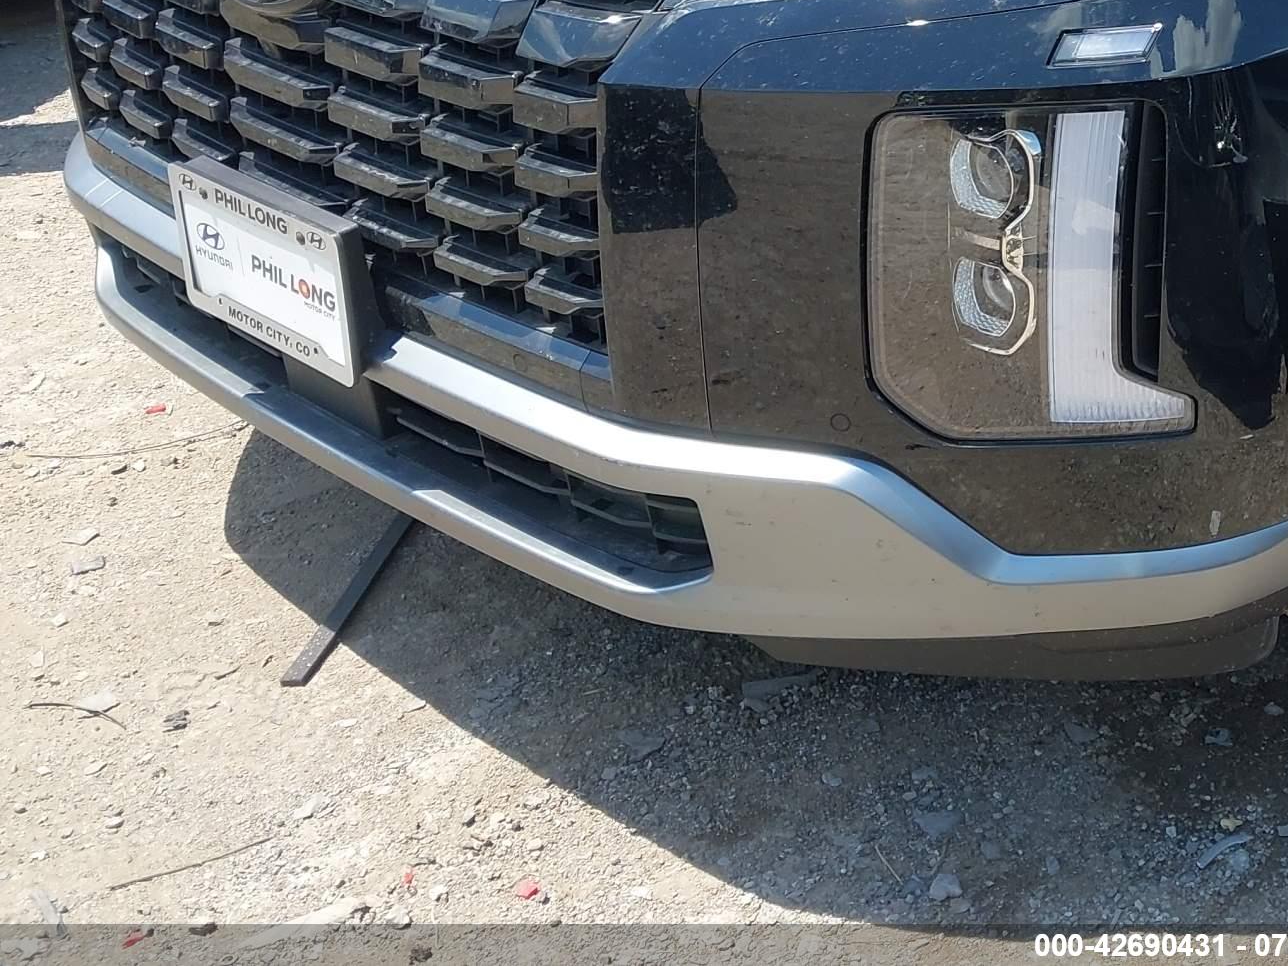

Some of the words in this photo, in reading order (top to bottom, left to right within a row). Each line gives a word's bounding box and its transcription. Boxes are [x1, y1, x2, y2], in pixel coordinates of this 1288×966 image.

[214, 188, 246, 215] PHIL
[246, 203, 288, 234] LONG
[195, 244, 234, 271] HYUNDAI
[251, 254, 287, 289] PHIL
[290, 274, 336, 312] LONG
[228, 305, 263, 333] MOTOR
[295, 340, 310, 357] CO
